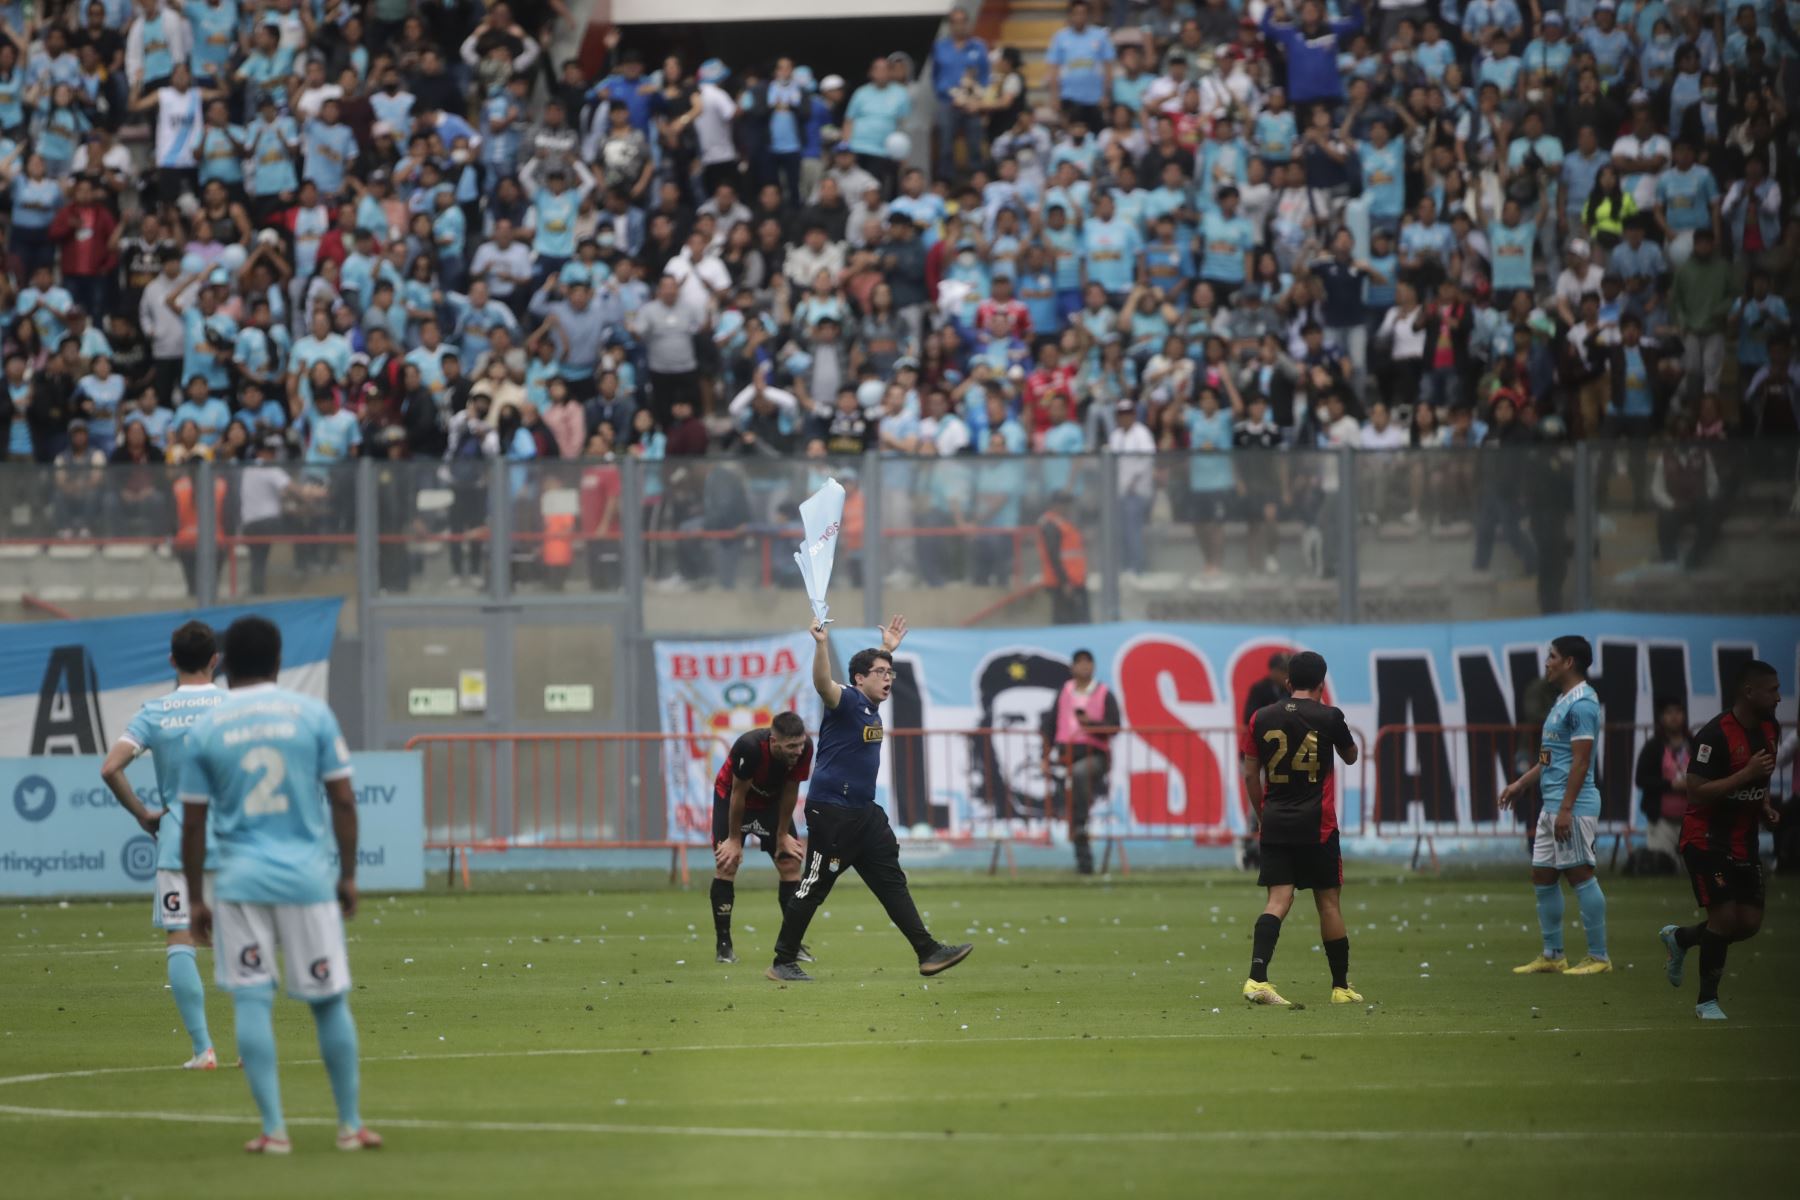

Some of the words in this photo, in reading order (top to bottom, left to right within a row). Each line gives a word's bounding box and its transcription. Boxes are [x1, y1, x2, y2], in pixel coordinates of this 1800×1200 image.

[671, 648, 800, 680] BUDA
[1263, 729, 1320, 783] 24
[240, 747, 289, 816] 2
[163, 891, 181, 912] G
